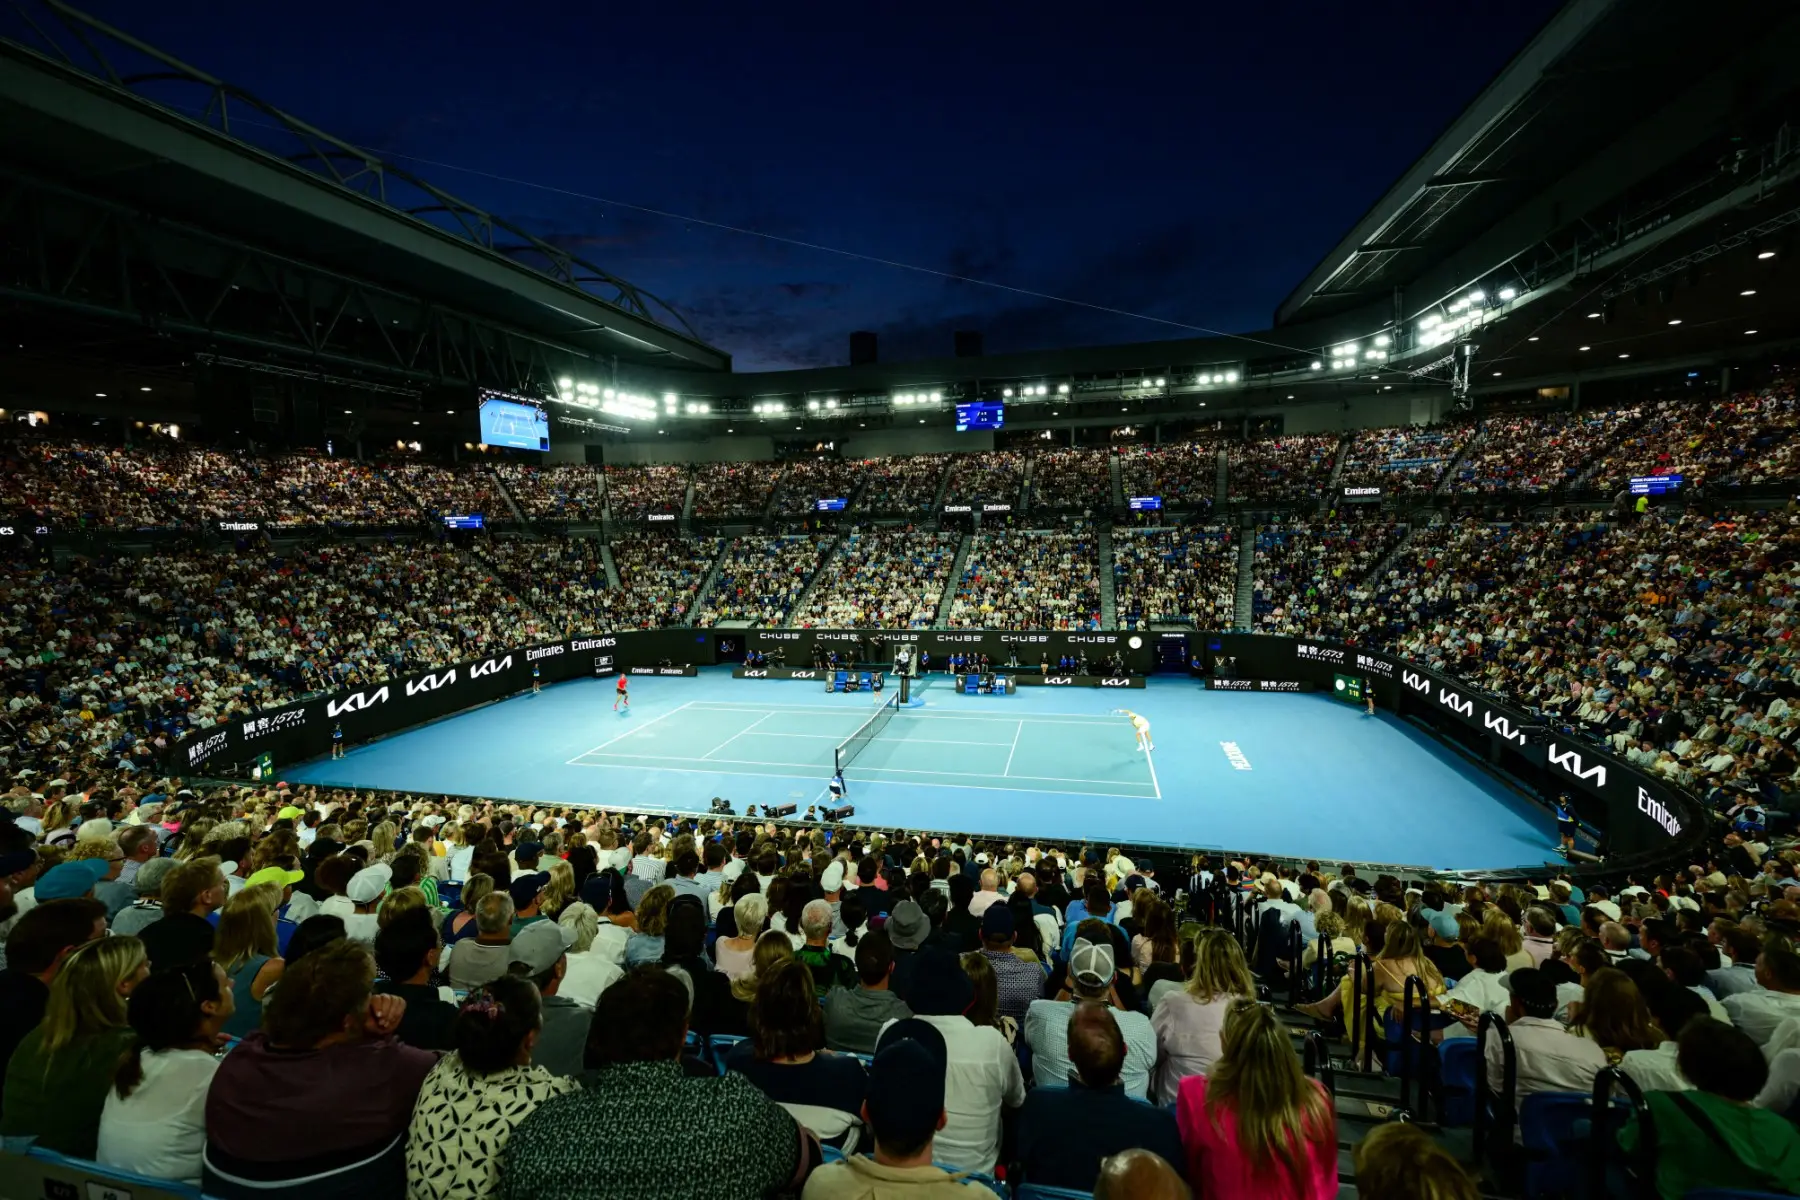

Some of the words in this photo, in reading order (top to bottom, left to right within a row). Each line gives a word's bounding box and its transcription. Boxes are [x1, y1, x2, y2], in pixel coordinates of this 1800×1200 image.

[1344, 486, 1380, 496] Emirates
[983, 503, 1011, 511] Emirates
[648, 513, 675, 521] Emirates
[219, 521, 259, 531] Emirates
[526, 644, 564, 661] Emirates
[571, 636, 616, 652] Emirates
[470, 655, 513, 679] KIA
[406, 669, 457, 696] KIA
[1044, 677, 1072, 685] KIA
[1101, 678, 1130, 686] KIA
[1402, 669, 1431, 695] KIA
[327, 686, 390, 718] KIA
[1439, 688, 1474, 718] KIA
[1484, 710, 1526, 746] KIA
[1548, 742, 1607, 788] KIA
